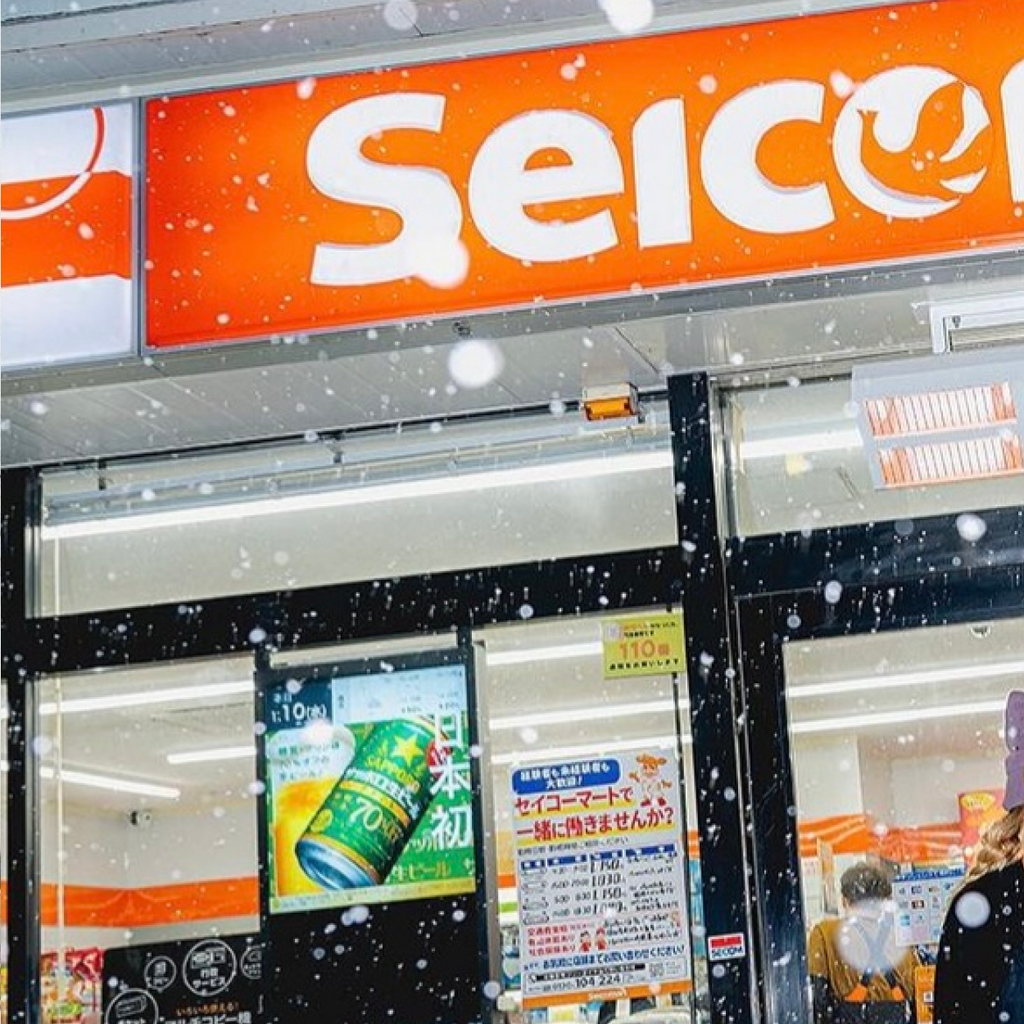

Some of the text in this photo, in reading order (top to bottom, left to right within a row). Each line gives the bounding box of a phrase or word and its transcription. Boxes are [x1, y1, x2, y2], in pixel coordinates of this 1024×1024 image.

[515, 786, 634, 816] セイコーマートで
[711, 947, 743, 959] SECOM
